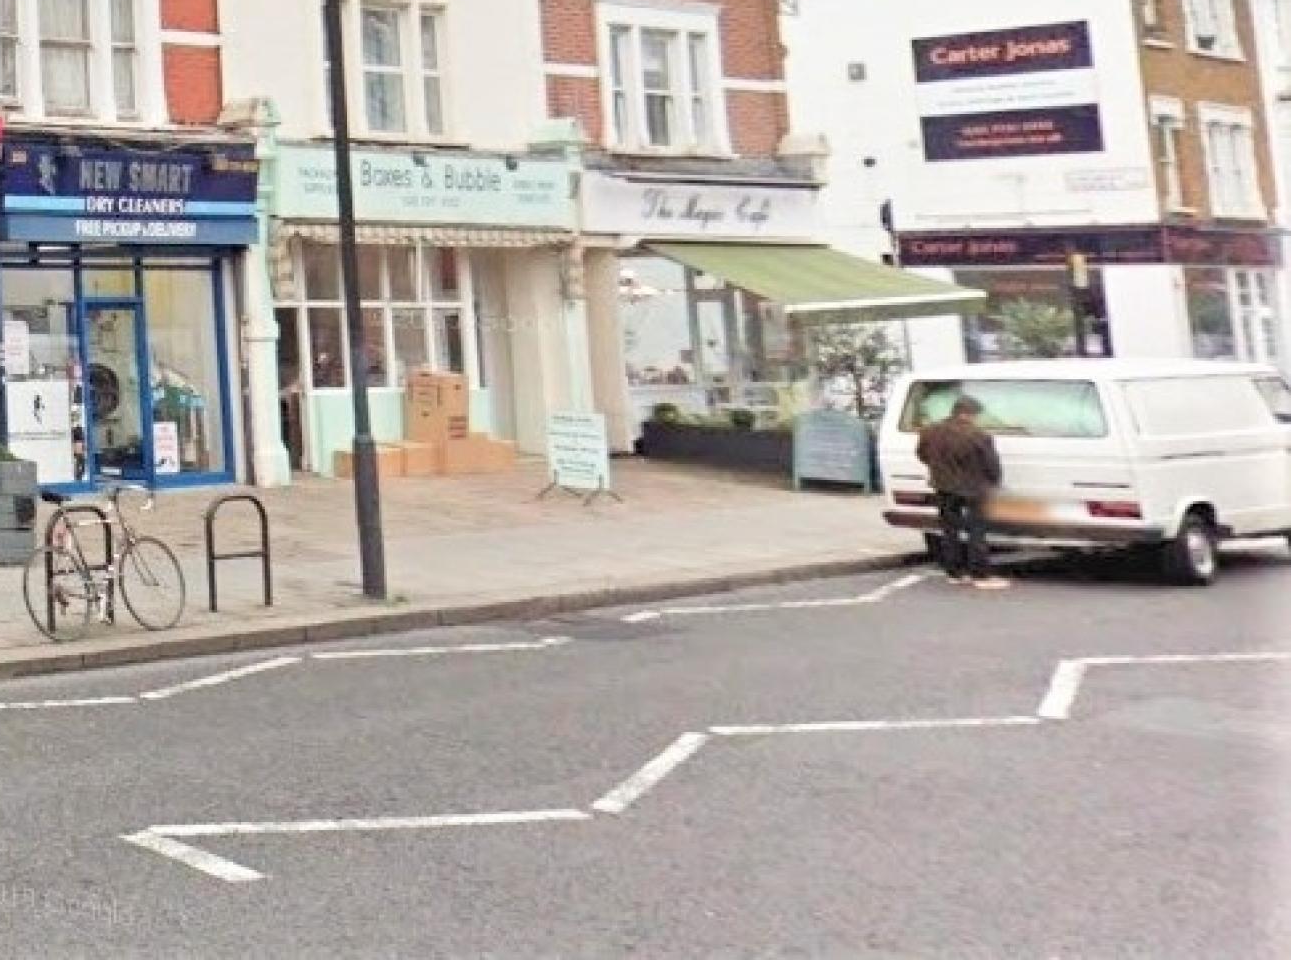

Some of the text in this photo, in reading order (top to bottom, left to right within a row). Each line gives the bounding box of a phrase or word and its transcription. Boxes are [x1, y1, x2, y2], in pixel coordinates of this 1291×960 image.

[930, 39, 1072, 65] Carter Jonas
[78, 159, 123, 190] NEW
[128, 161, 194, 193] SMART
[360, 159, 412, 187] Boxes
[420, 171, 433, 189] &
[444, 163, 502, 192] Bubble
[86, 196, 185, 215] DRY CLEANERS
[75, 219, 101, 236] FREE
[148, 222, 197, 237] DELIVERY
